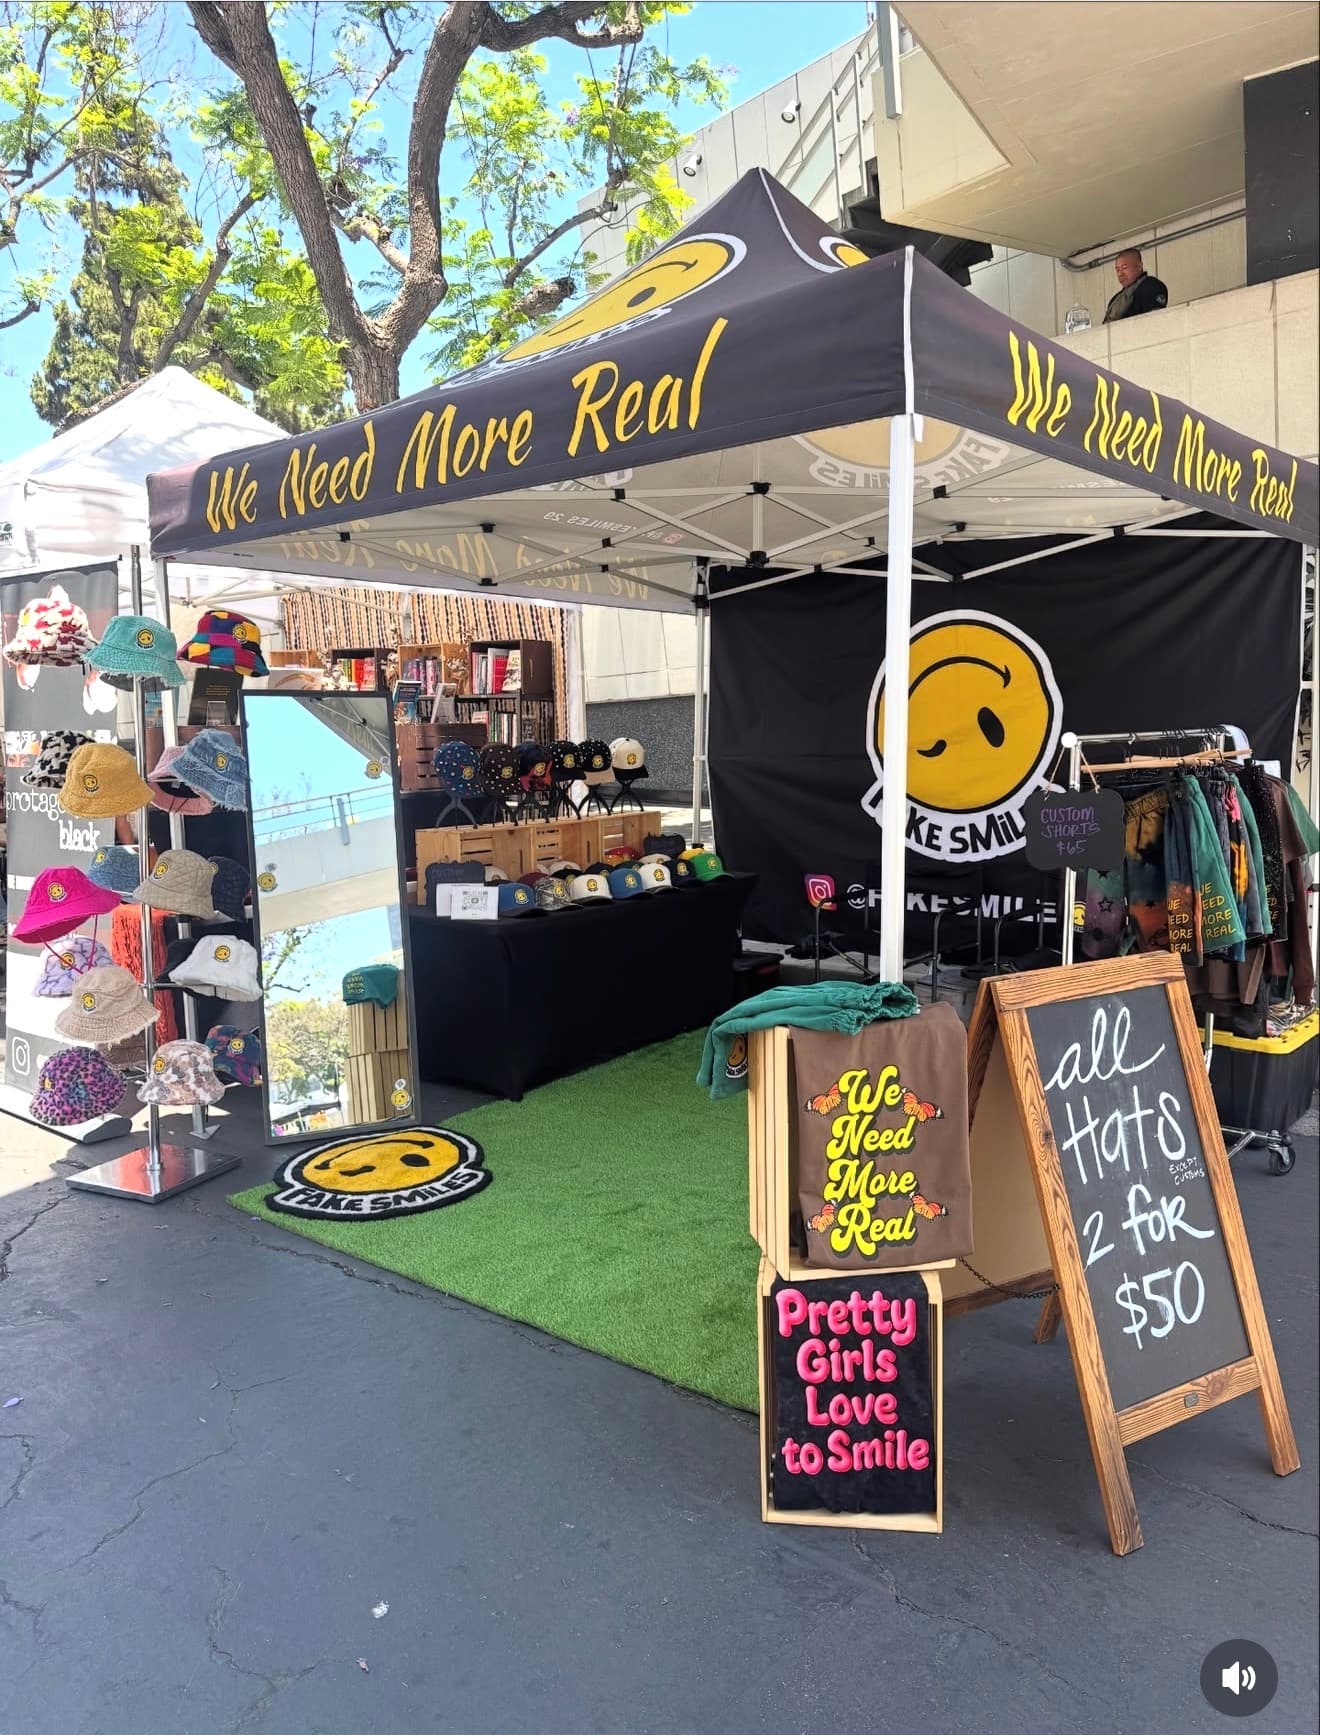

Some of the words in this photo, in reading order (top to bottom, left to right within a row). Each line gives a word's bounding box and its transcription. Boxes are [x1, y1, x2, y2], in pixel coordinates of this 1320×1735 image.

[206, 462, 257, 534] We
[279, 421, 377, 519] Need
[396, 404, 533, 494] More
[568, 317, 728, 456] Real
[1007, 330, 1072, 438] We
[1084, 373, 1163, 474] Need
[1173, 414, 1243, 504] More
[1249, 449, 1300, 522] Real
[59, 820, 100, 852] black
[950, 803, 1030, 854] SMiL
[1040, 806, 1095, 824] CUSTOM
[1040, 822, 1101, 839] SHORTS
[1056, 840, 1087, 856] $65
[847, 884, 1057, 923] @FKESMILE
[1169, 913, 1190, 925] EED
[1202, 895, 1225, 911] EED
[1205, 924, 1237, 939] REAL
[1044, 1006, 1166, 1090] all
[837, 1064, 903, 1115] We
[826, 1114, 917, 1161] Need
[281, 1186, 364, 1213] FAKE
[823, 1158, 918, 1210] More
[830, 1202, 916, 1256] Real
[1083, 1210, 1115, 1268] 2
[774, 1288, 917, 1347] Pretty
[1115, 1261, 1205, 1350] $50
[797, 1338, 898, 1383] Girls
[806, 1386, 898, 1427] Love
[781, 1434, 824, 1476] to
[826, 1429, 931, 1474] Smile
